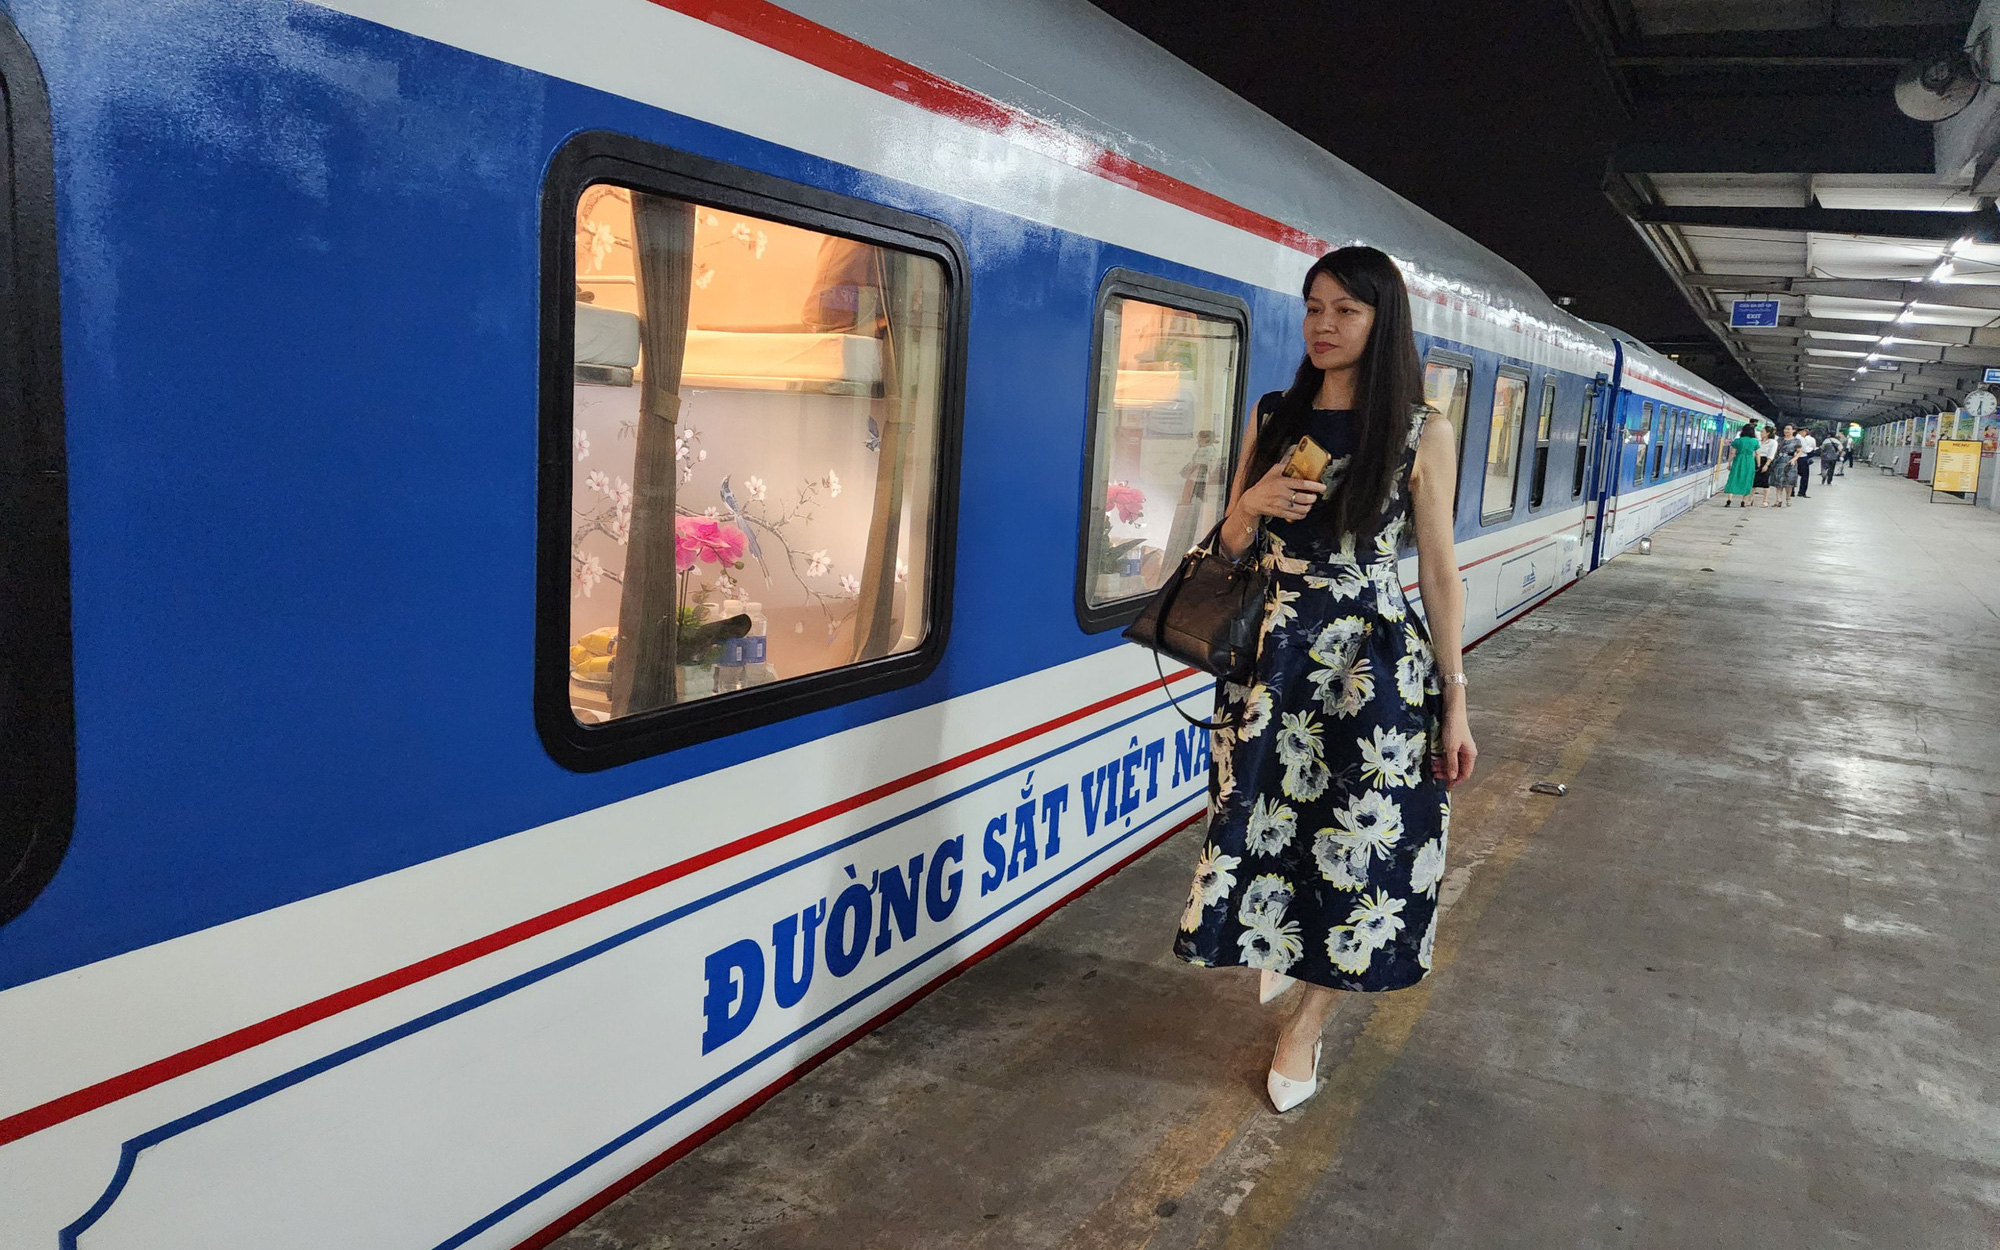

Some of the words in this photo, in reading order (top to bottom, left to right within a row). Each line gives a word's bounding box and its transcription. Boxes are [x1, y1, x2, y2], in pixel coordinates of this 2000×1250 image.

[701, 834, 964, 1057] ĐƯỜNG
[979, 769, 1070, 898] SẮT
[1080, 735, 1166, 837] VIỆT
[1171, 715, 1212, 789] NA
